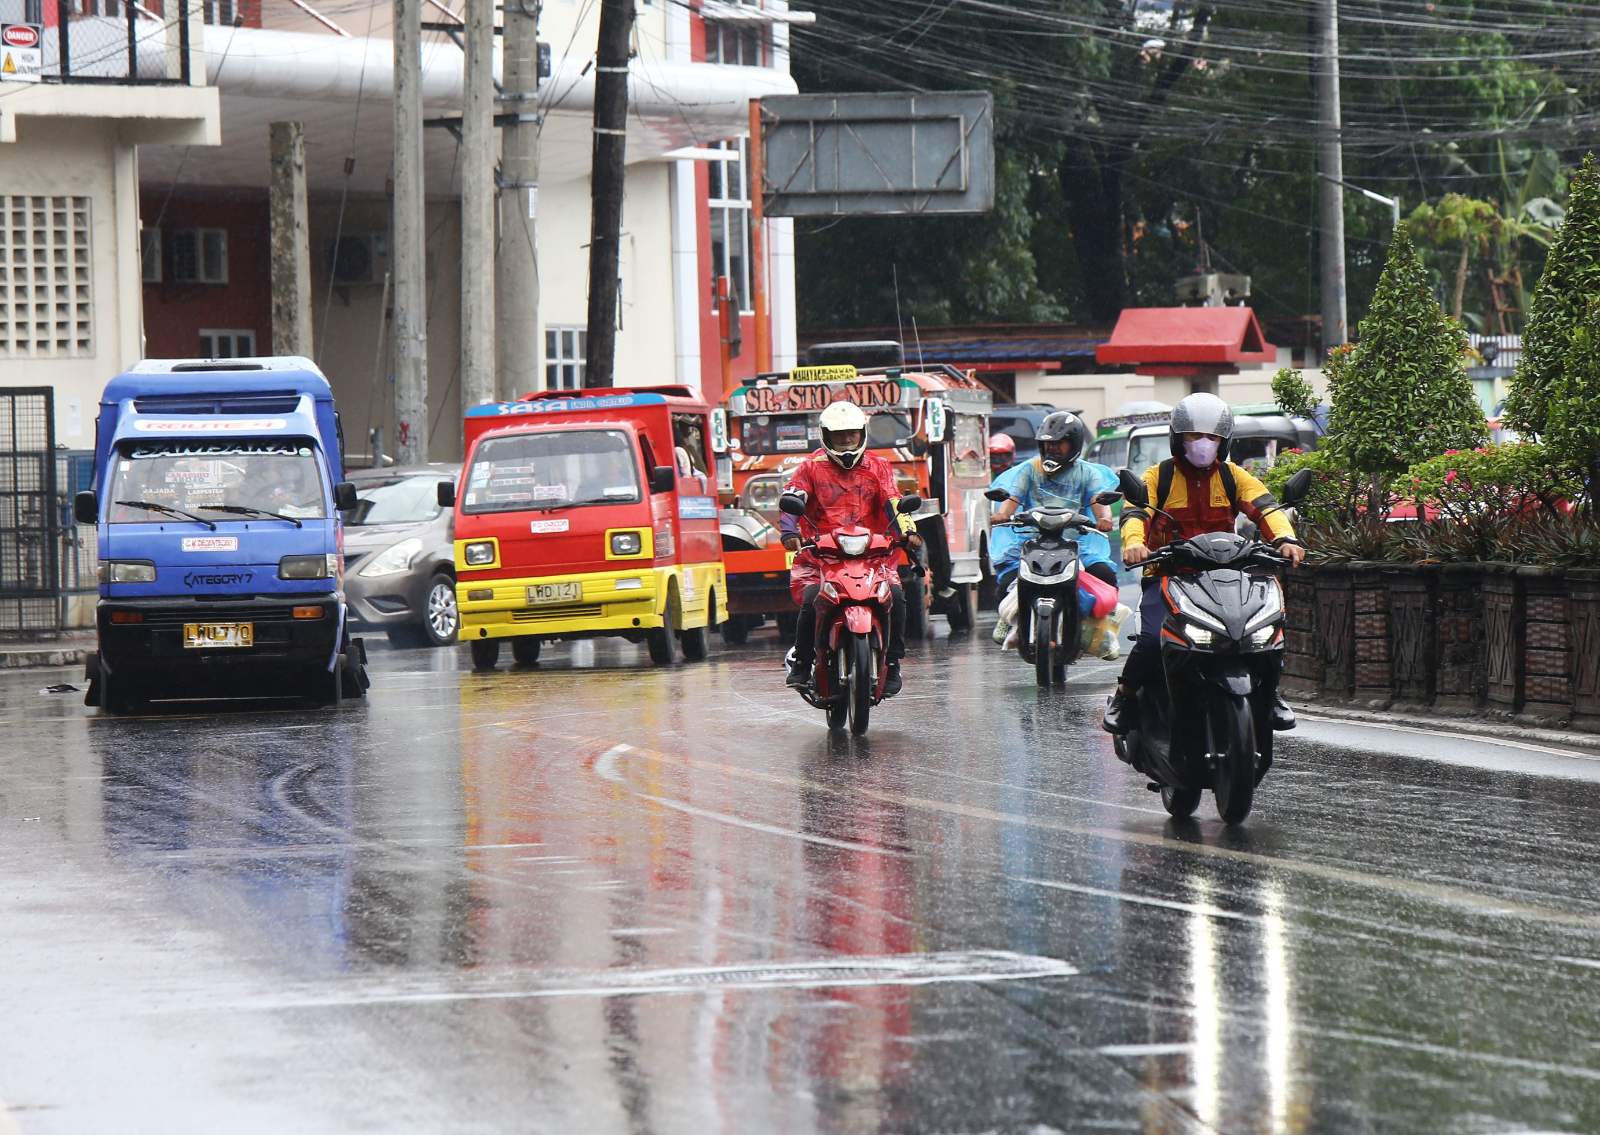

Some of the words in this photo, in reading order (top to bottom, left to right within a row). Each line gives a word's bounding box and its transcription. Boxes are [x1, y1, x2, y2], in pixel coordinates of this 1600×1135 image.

[7, 31, 35, 42] DANGER
[745, 387, 781, 413] SR.
[787, 383, 832, 409] STO
[498, 401, 568, 415] SASA
